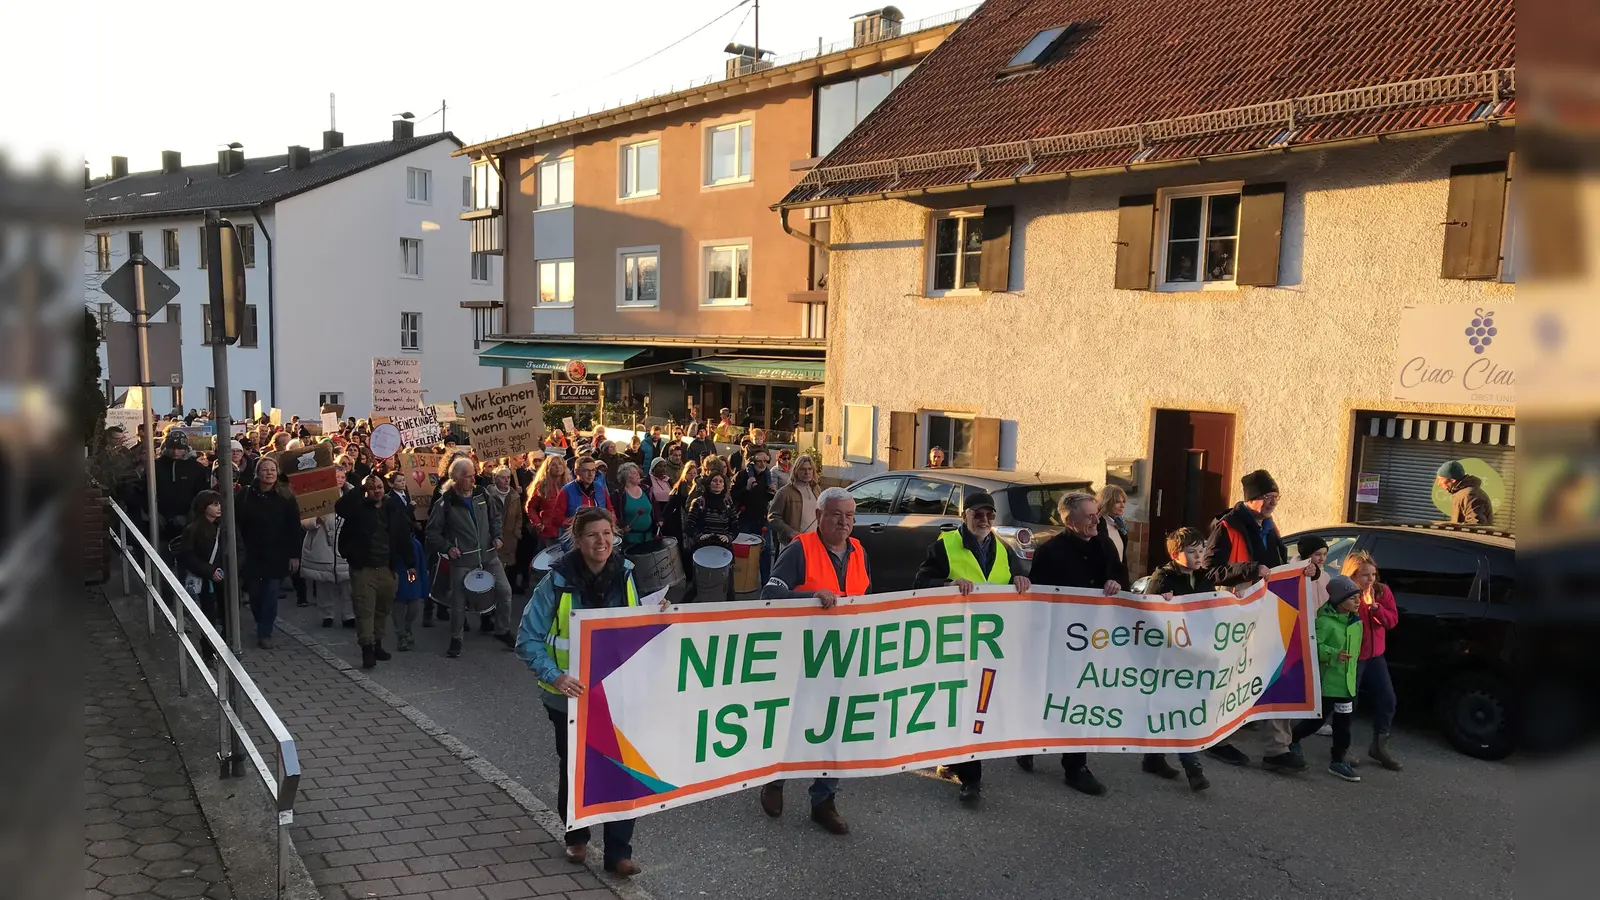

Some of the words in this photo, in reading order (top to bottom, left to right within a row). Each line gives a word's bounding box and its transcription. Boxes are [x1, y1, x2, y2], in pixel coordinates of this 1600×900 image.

[376, 359, 390, 367] AUS
[1400, 357, 1457, 389] Ciao
[465, 394, 487, 411] Wir
[488, 389, 534, 407] können
[560, 385, 596, 396] L'Olive
[1471, 393, 1494, 402] OBST
[471, 411, 493, 423] was
[497, 404, 527, 420] dafür,
[471, 422, 507, 437] wenn
[511, 416, 534, 430] wir
[478, 436, 505, 450] nichts
[508, 432, 531, 447] gegen
[483, 448, 508, 460] Nazis
[1066, 619, 1192, 651] Seefeld
[677, 631, 782, 693] NIE
[803, 613, 1005, 679] WIEDER
[1043, 693, 1124, 729] Hass
[1147, 698, 1207, 734] und
[695, 697, 790, 763] IST
